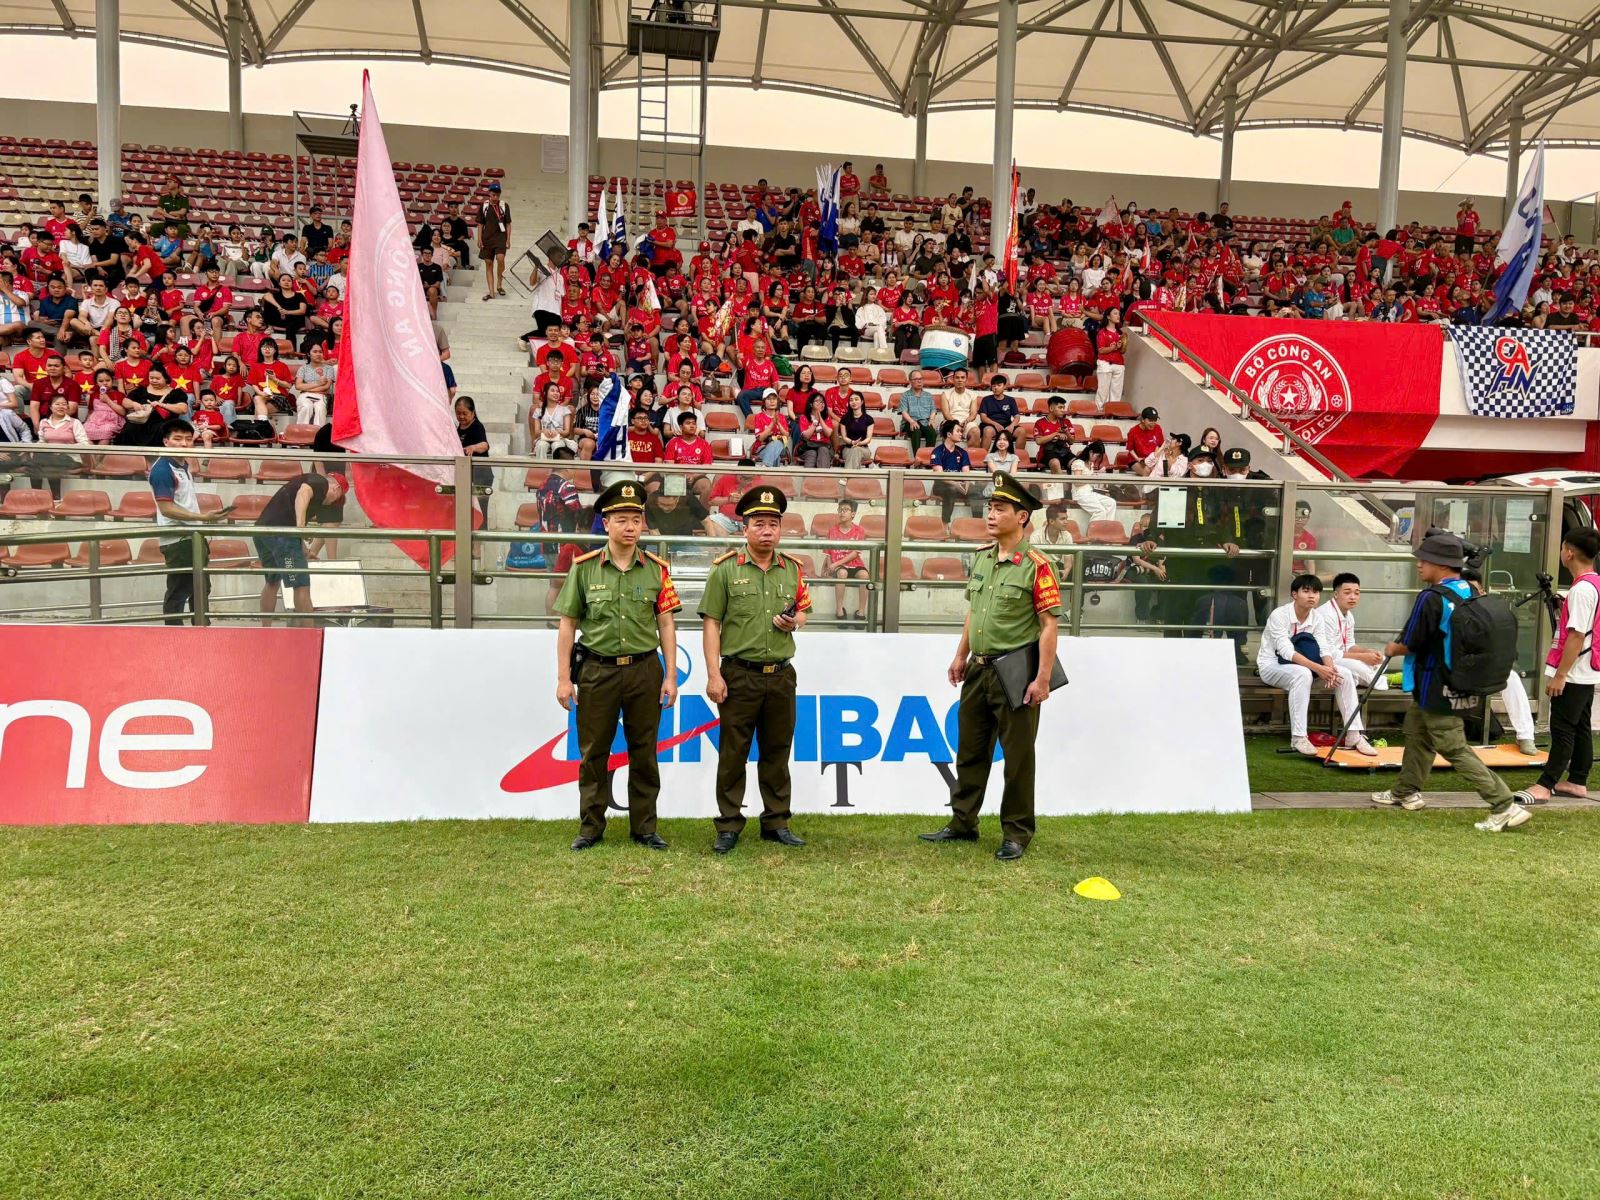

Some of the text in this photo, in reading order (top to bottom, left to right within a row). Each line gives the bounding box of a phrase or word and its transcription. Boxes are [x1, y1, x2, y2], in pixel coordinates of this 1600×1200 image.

[1244, 343, 1333, 380] BỘ CÔNG AN
[1317, 414, 1334, 428] FC
[567, 694, 1004, 763] INBA
